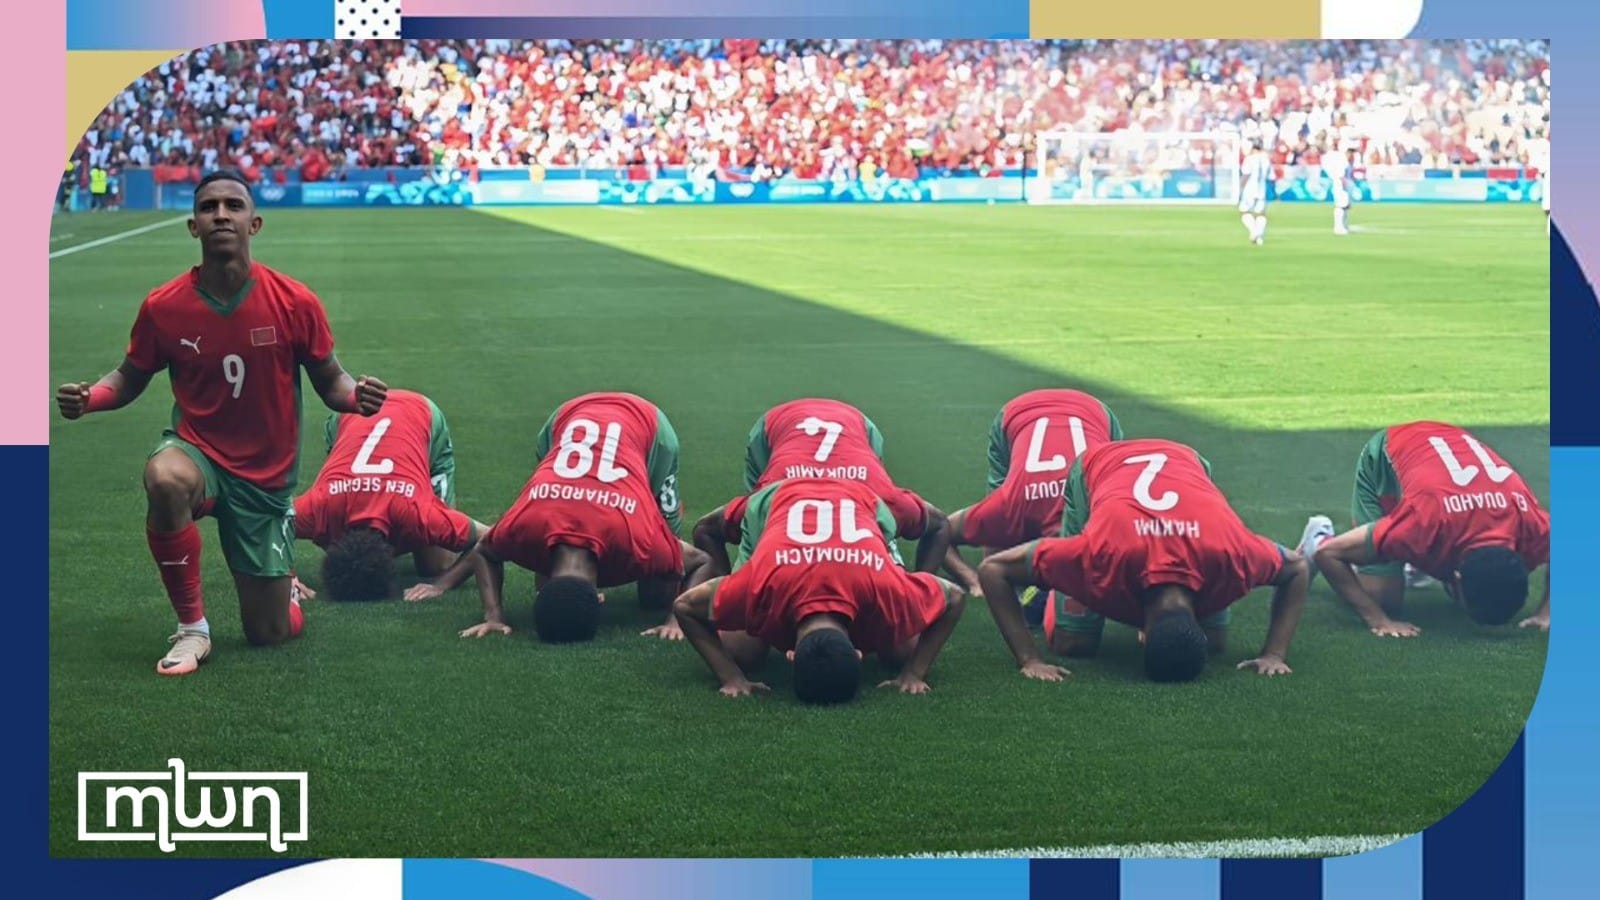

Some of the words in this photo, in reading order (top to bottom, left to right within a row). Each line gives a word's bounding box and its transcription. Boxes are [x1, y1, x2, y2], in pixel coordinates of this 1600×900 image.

[223, 354, 245, 399] 9
[351, 417, 394, 474] 7
[553, 418, 629, 483] 18
[796, 416, 843, 462] 4
[1025, 416, 1087, 473] 17
[1427, 434, 1513, 487] 11
[328, 476, 381, 495] SEGHIR
[385, 479, 416, 498] BEN
[785, 465, 868, 481] BOUKAMIR
[1123, 453, 1179, 511] 2
[528, 482, 637, 515] RICHARDSON
[786, 498, 874, 544] 10
[1443, 491, 1507, 514] OUAHDI
[775, 546, 884, 572] AKHOMACH
